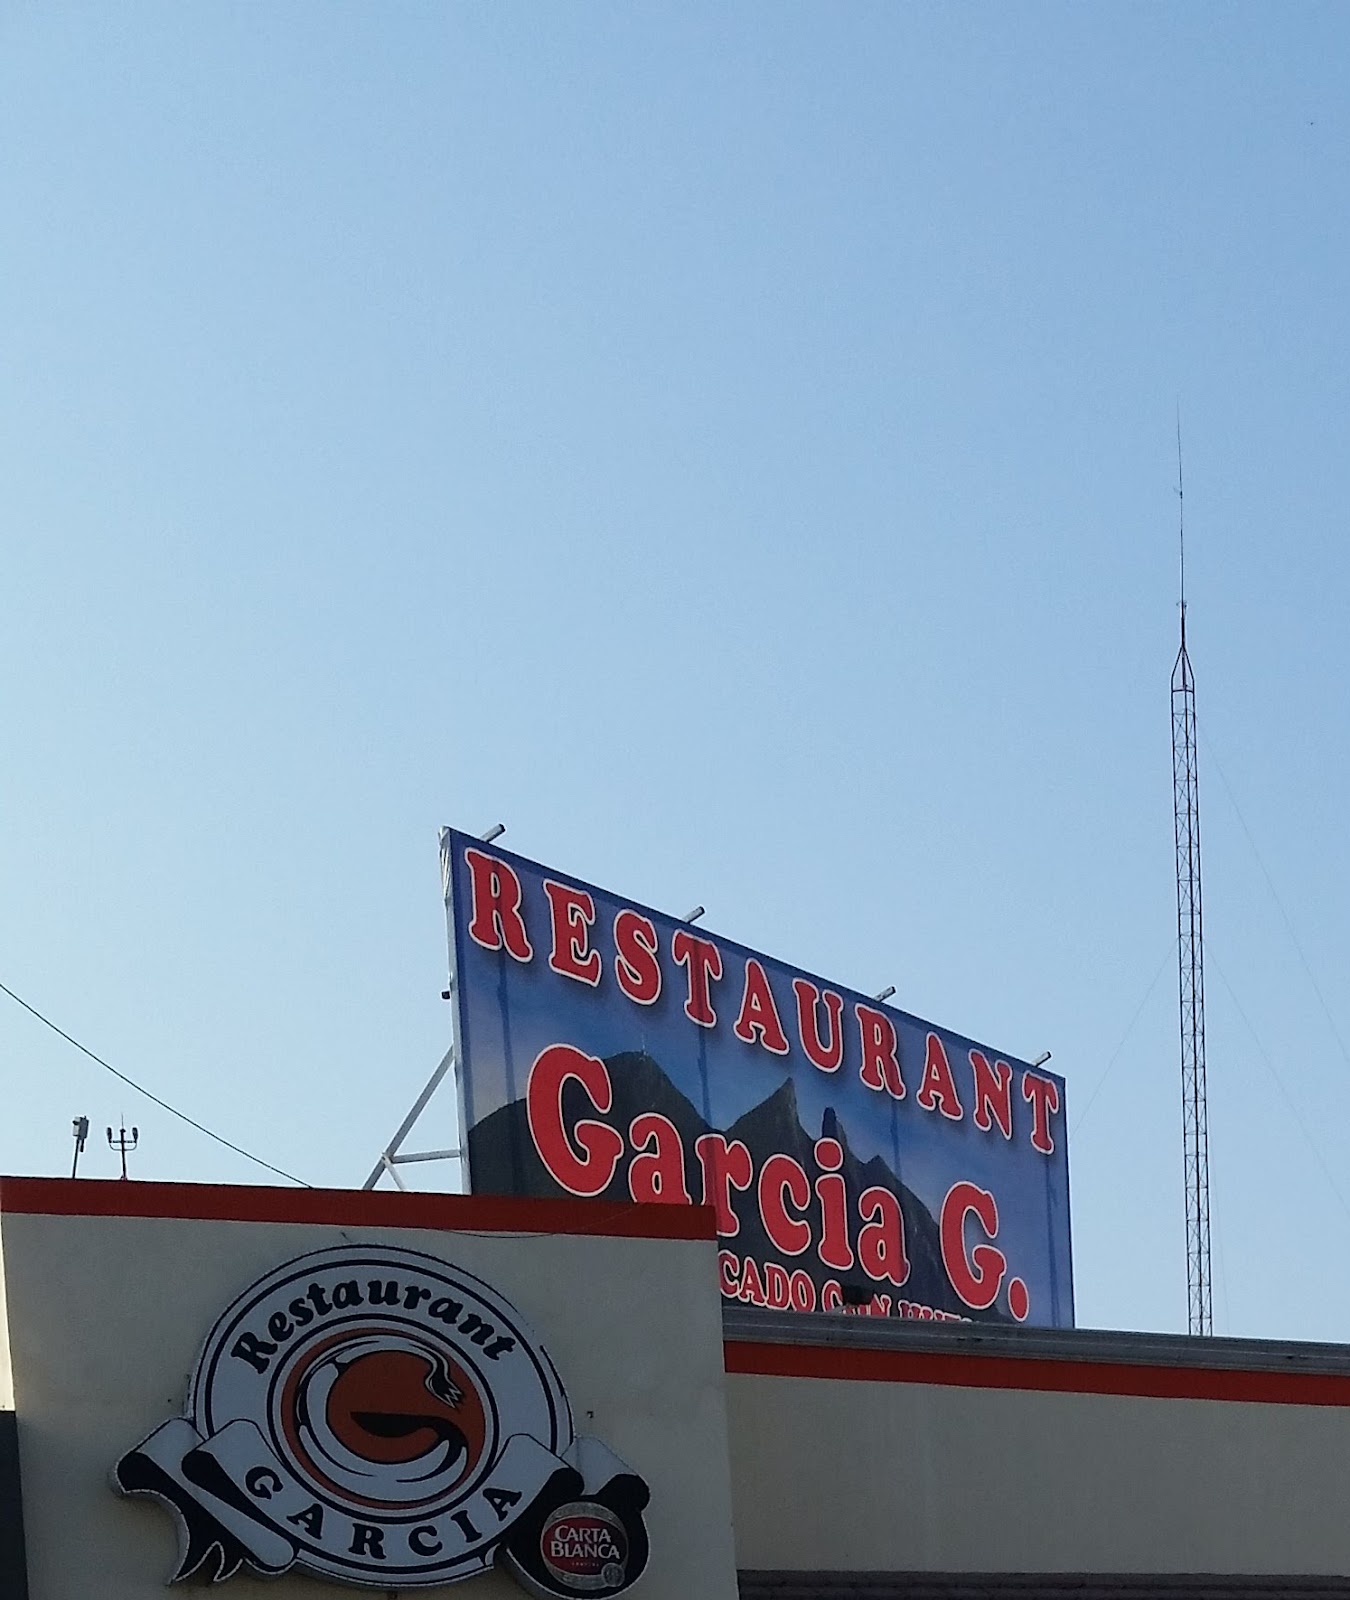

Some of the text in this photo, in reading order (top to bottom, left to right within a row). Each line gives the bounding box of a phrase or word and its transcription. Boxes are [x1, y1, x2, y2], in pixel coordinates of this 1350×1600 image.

[463, 846, 1060, 1156] RESTAURANT
[526, 1043, 1030, 1323] Garcia G.
[230, 1277, 517, 1376] Restaurant
[244, 1465, 524, 1560] GARCIA
[550, 1540, 621, 1560] BLANCA
[554, 1525, 612, 1544] CARTA
